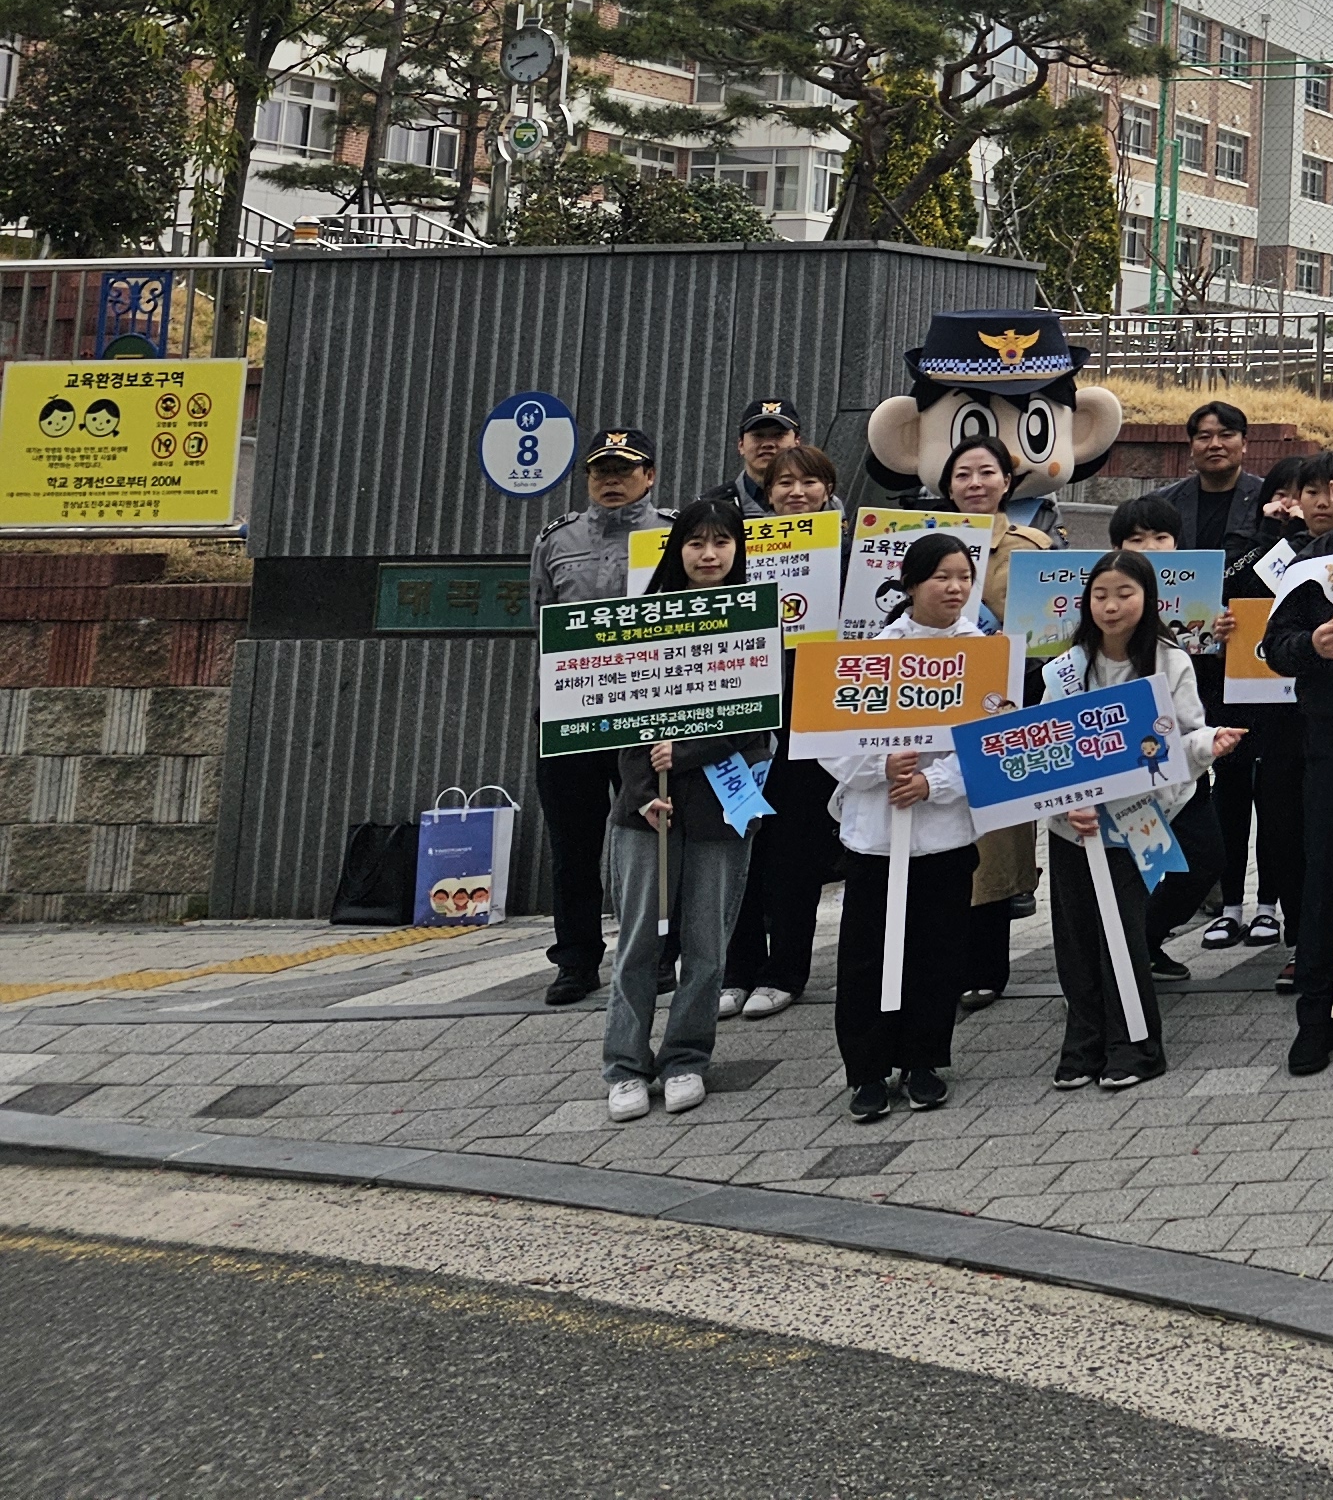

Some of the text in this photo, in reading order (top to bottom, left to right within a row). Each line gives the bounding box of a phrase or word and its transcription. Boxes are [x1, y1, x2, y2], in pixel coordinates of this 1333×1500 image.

[65, 371, 184, 389] 교육환경보호구역
[517, 435, 538, 466] 8
[47, 476, 181, 489] 학교 경계선으로부터 200M
[508, 469, 543, 479] 소호로
[766, 541, 792, 552] 200M
[780, 566, 810, 578] 시설을
[866, 558, 883, 569] 학교
[1161, 569, 1195, 586] 있어
[565, 591, 758, 631] 교육환경보호구역
[596, 620, 728, 643] 학교 경계선으로부터 200M
[555, 636, 767, 672] 교육환경보호구역내 금지 행위 및 시설을
[836, 652, 966, 683] 폭력 Stop!
[554, 655, 768, 692] 설치하기 전에는 반드시 보호구역 저촉여부 확인
[608, 692, 626, 704] 임대
[630, 688, 648, 700] 계약
[651, 687, 661, 699] 및
[664, 683, 683, 696] 시설
[685, 681, 704, 693] 투자
[707, 679, 717, 690] 전
[720, 676, 742, 689] 확인)
[834, 683, 963, 714] 욕설 Stop!
[612, 707, 714, 731] 경상남도진주교육지원청
[716, 701, 762, 716] 학생건강과
[857, 733, 934, 749] 무지개초등학교
[981, 703, 1128, 757] 폭력없는 학교
[1000, 732, 1126, 782] 행복한 학교
[1033, 786, 1105, 812] 무지개초등학교
